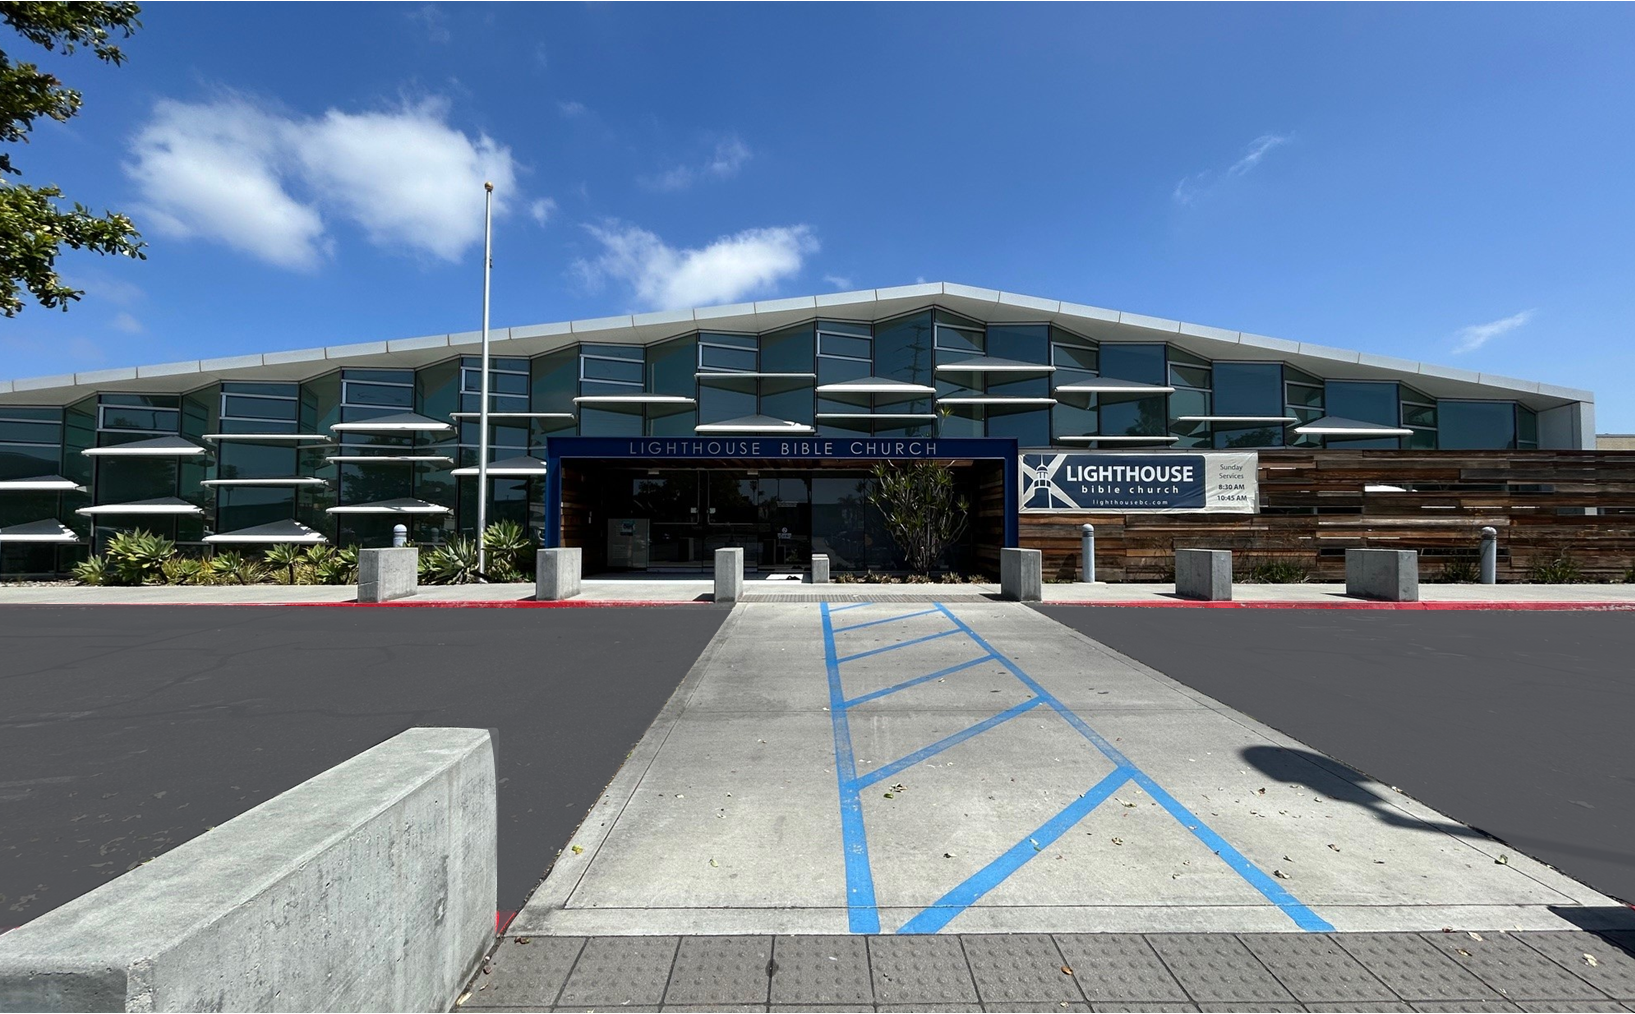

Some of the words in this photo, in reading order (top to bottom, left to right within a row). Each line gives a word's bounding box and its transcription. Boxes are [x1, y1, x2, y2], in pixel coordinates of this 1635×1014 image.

[629, 441, 761, 455] LIGHTHOUSE
[781, 441, 833, 455] BIBLE
[850, 441, 937, 455] CHURCH
[1066, 465, 1194, 482] LIGHTHOUSE
[1081, 485, 1120, 494] bible
[1129, 485, 1179, 494] church
